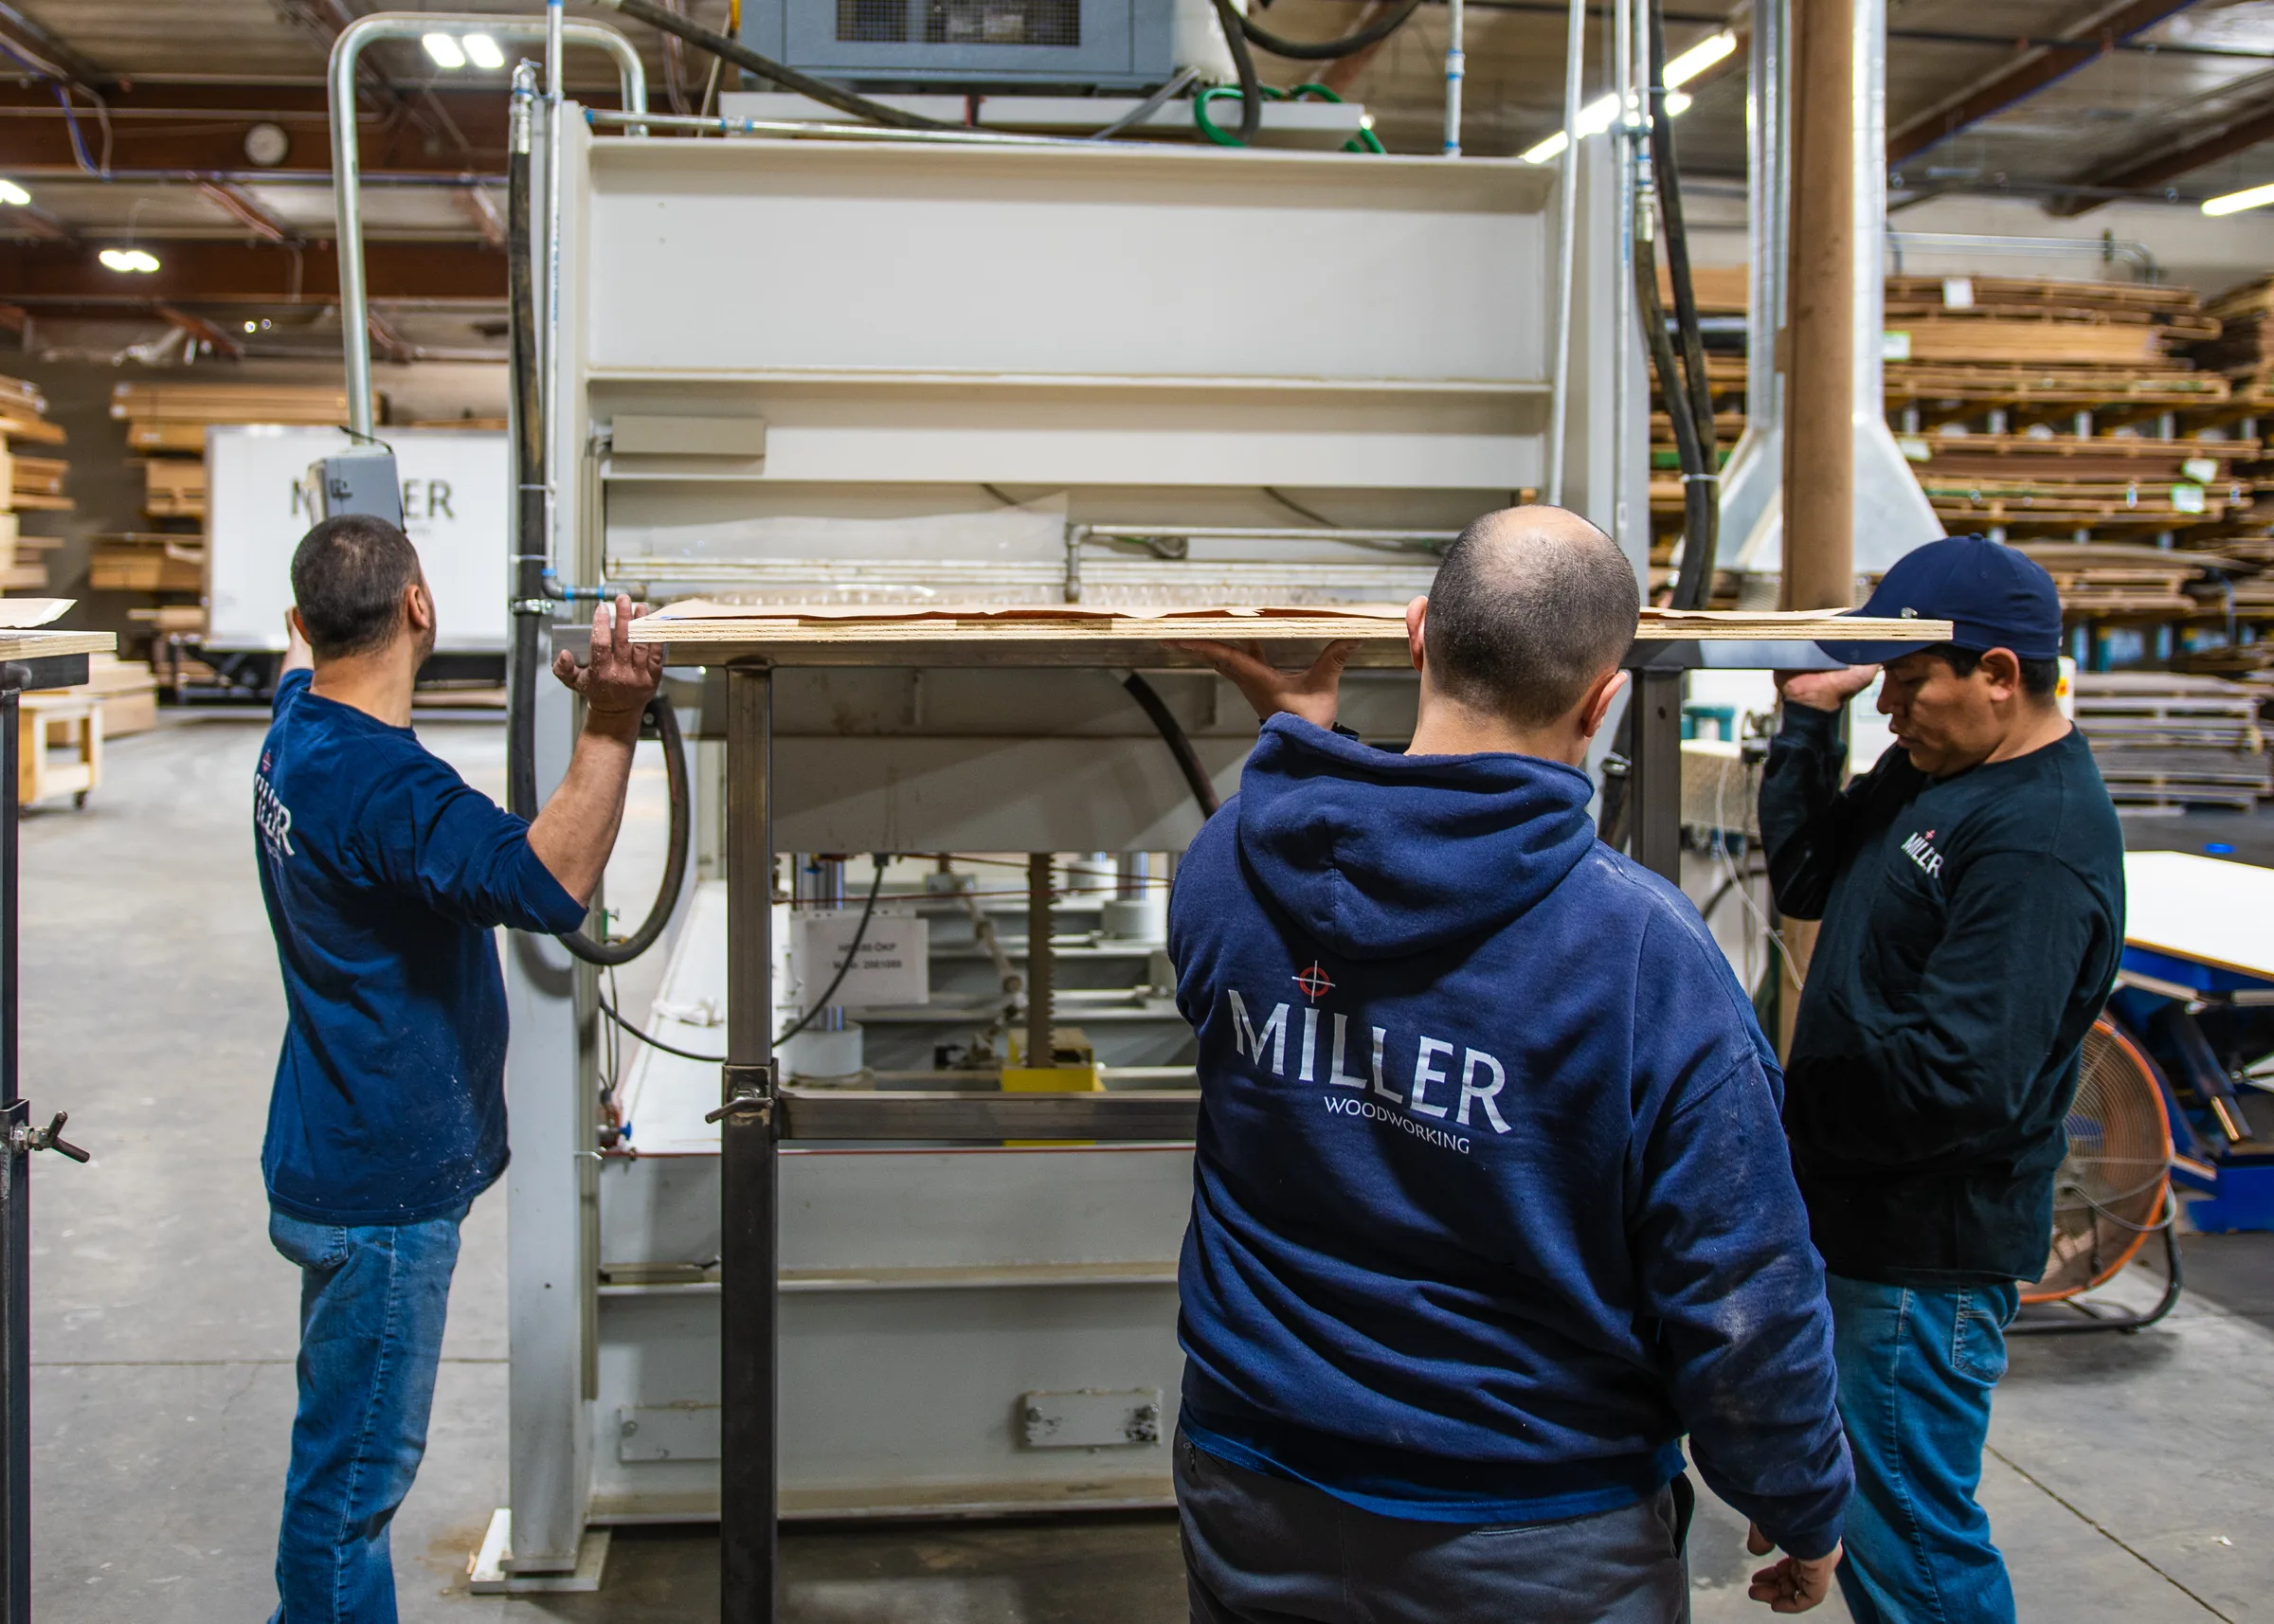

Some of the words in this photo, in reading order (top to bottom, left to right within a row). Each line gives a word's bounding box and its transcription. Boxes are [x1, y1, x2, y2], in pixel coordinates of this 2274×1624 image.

[291, 478, 456, 520] MER
[255, 773, 296, 856] ILLER
[1228, 989, 1512, 1133] MILLER
[1324, 1096, 1471, 1154] WOODWORKING
